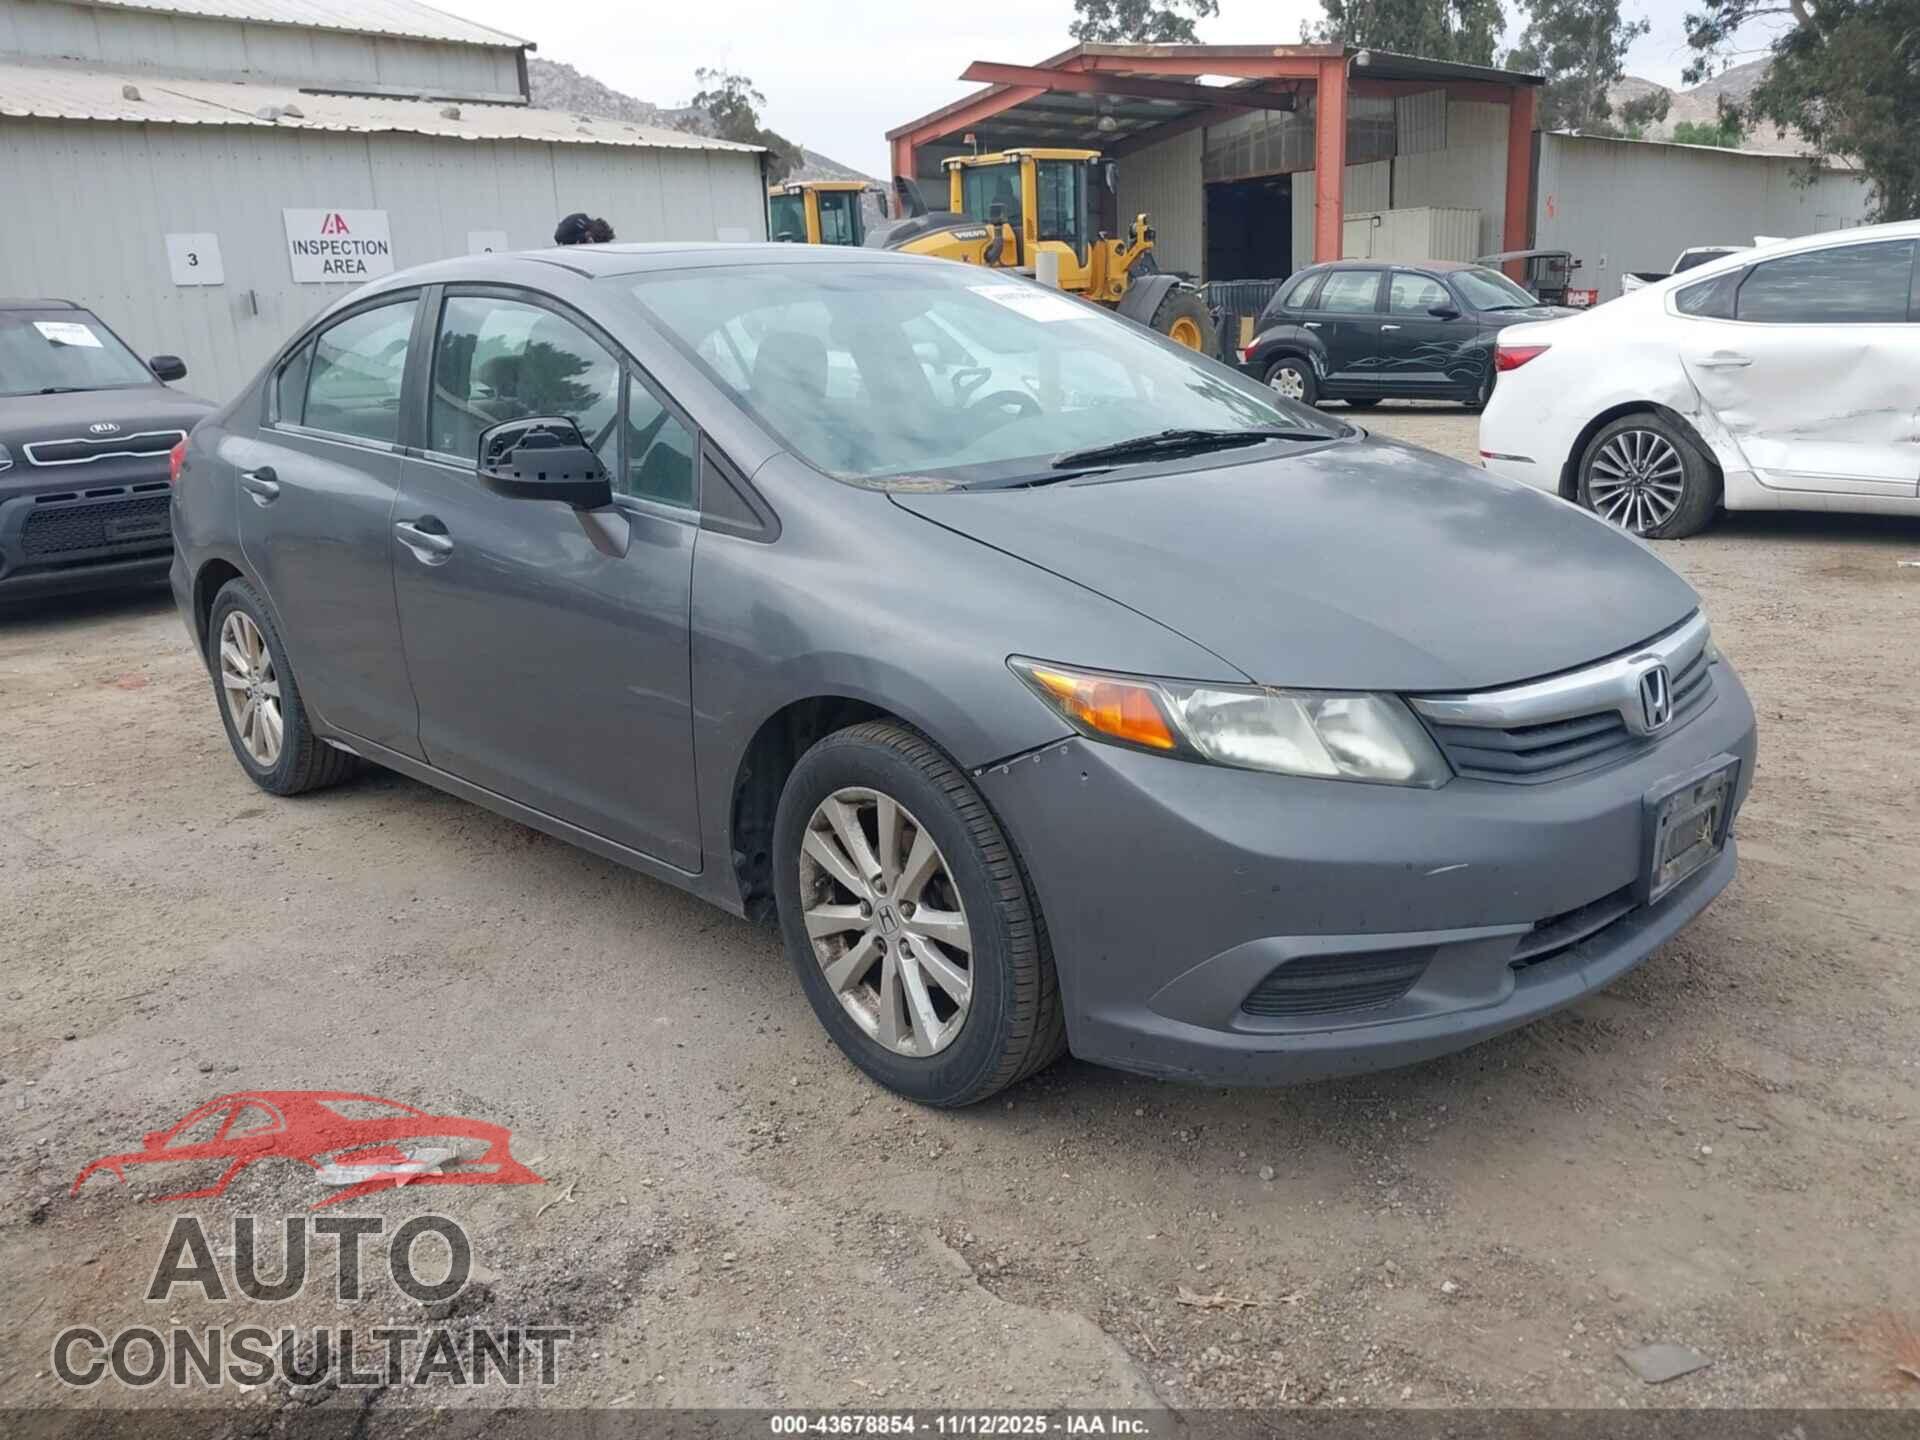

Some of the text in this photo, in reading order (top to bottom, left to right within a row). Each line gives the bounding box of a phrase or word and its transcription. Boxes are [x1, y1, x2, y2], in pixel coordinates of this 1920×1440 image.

[292, 240, 389, 255] INSPECTION
[187, 252, 199, 267] 3
[323, 259, 367, 274] AREA
